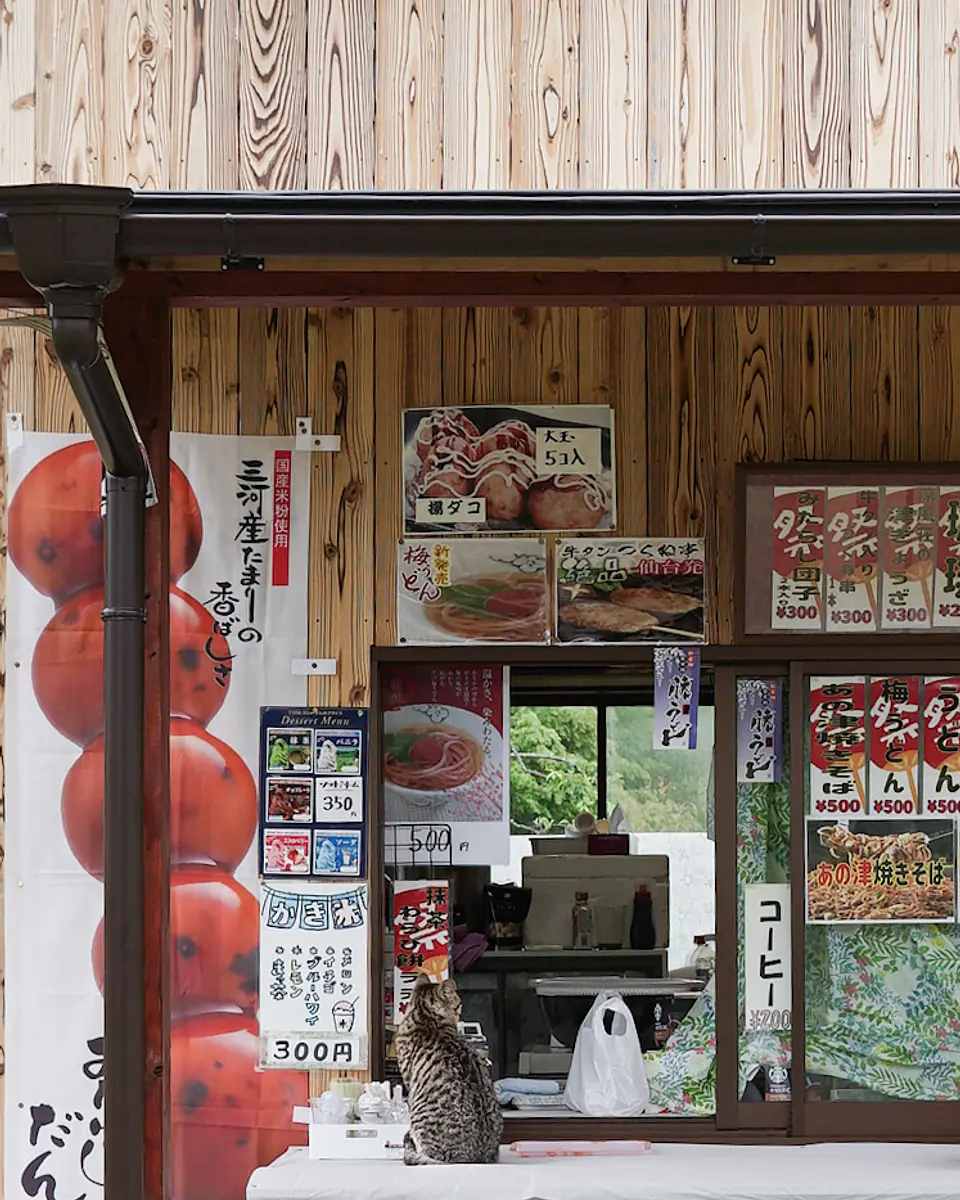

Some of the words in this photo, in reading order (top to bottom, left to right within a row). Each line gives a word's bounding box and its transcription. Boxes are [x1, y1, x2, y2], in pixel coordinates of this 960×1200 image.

[544, 430, 576, 444] 大玉
[273, 457, 291, 548] 国産米粉使用
[234, 460, 270, 643] 三河産たまりの
[791, 488, 820, 601] みたらし団子
[638, 559, 703, 575] 仙台発
[776, 605, 818, 620] ¥300
[831, 609, 873, 624] ¥300
[886, 607, 928, 622] ¥300
[204, 581, 240, 687] 香ばしさ
[881, 679, 909, 794] 梅うどん
[936, 686, 960, 793] うどん
[322, 795, 353, 811] 350
[816, 799, 861, 814] ¥500
[873, 799, 914, 815] ¥500
[409, 828, 450, 852] 500
[426, 886, 446, 931] 抹茶
[759, 900, 784, 1007] コーヒー
[273, 1040, 354, 1064] 300円
